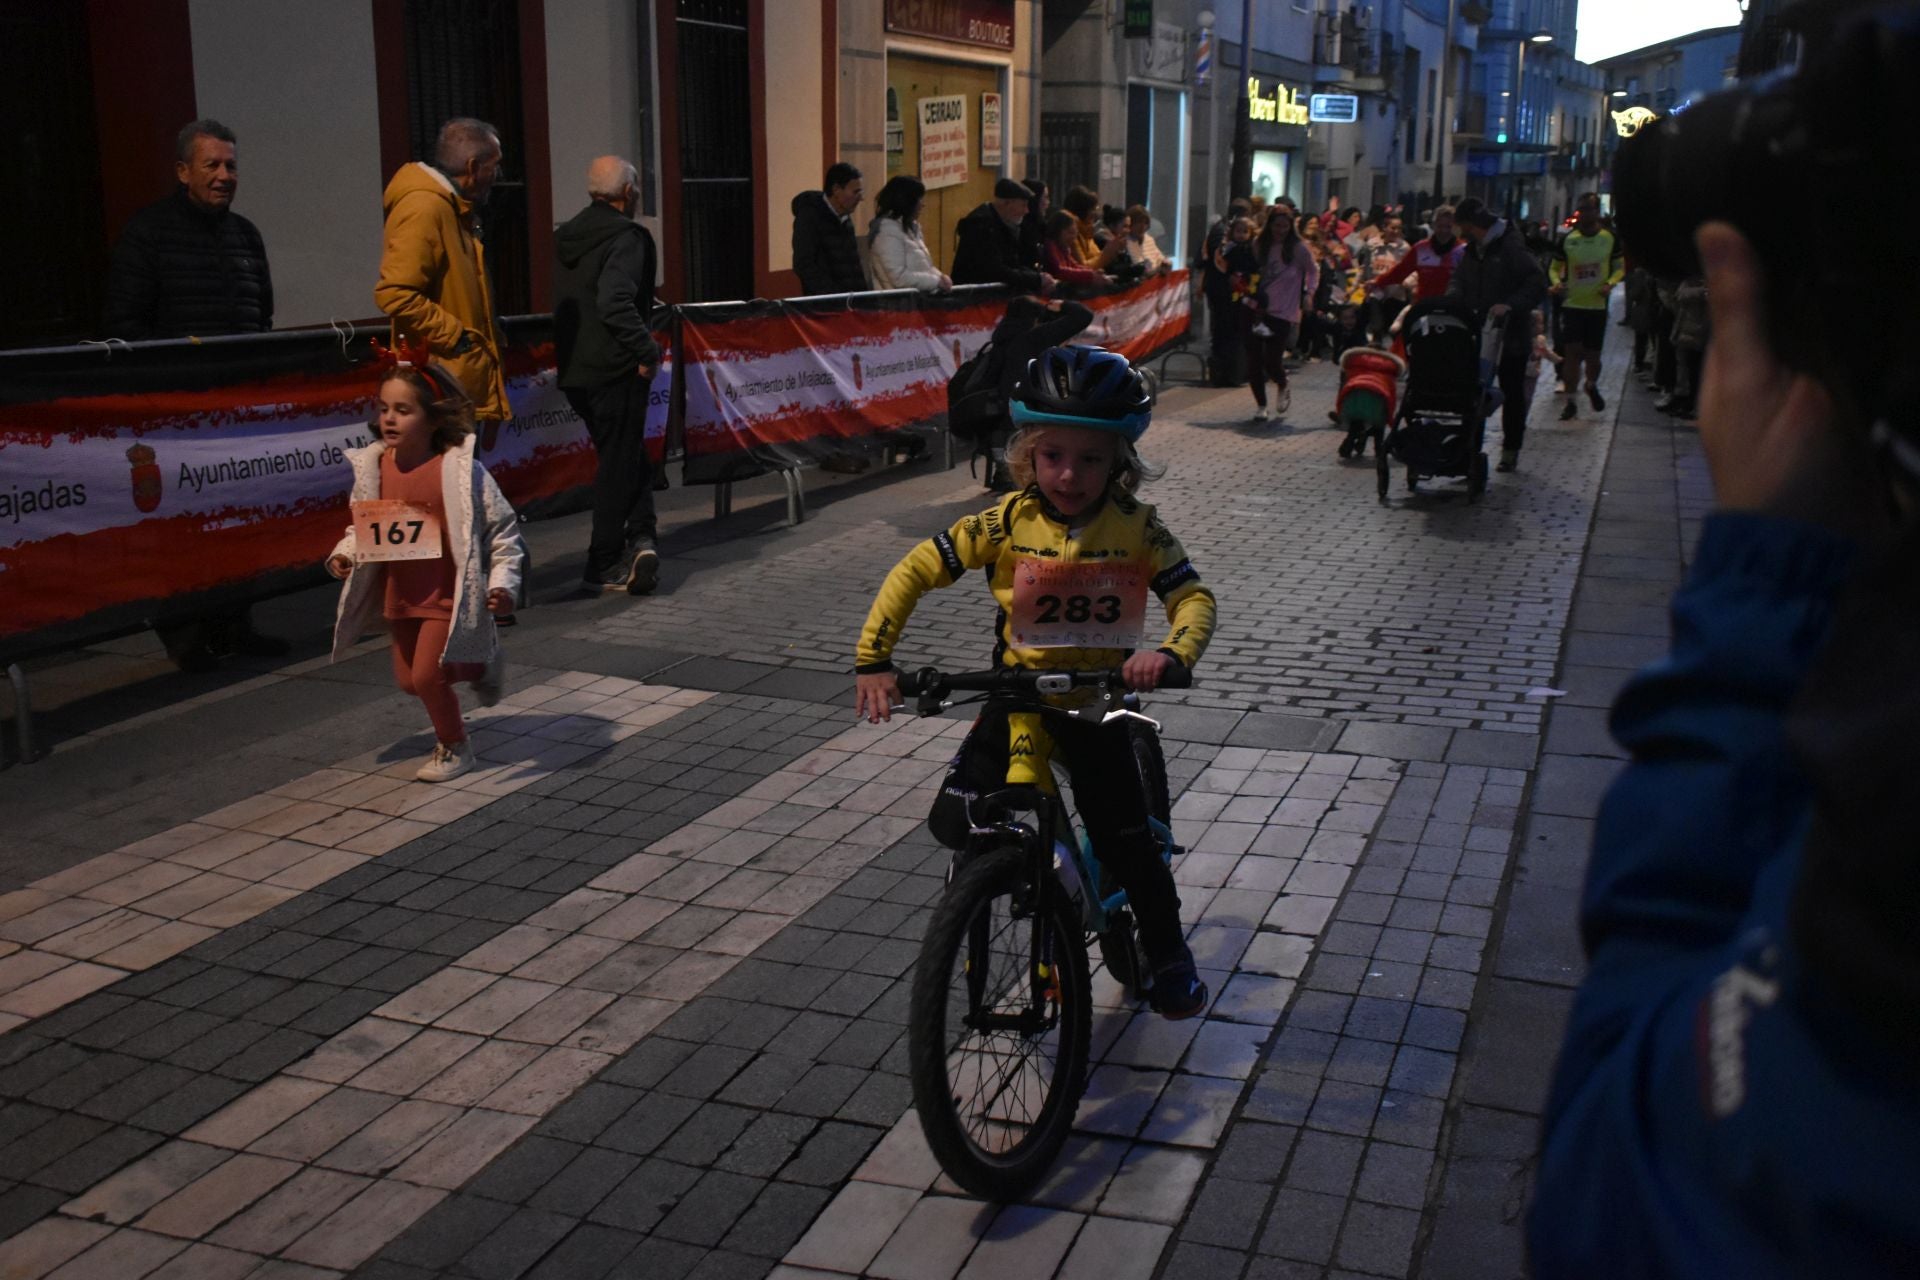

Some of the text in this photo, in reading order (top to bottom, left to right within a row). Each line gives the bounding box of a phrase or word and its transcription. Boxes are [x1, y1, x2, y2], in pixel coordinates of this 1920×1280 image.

[968, 19, 1011, 45] BOUTIQUE
[924, 100, 962, 125] CERRADO
[784, 372, 797, 391] de
[178, 451, 315, 493] Ayuntamiento
[320, 443, 344, 465] de
[370, 520, 424, 546] 167
[1034, 595, 1121, 624] 283
